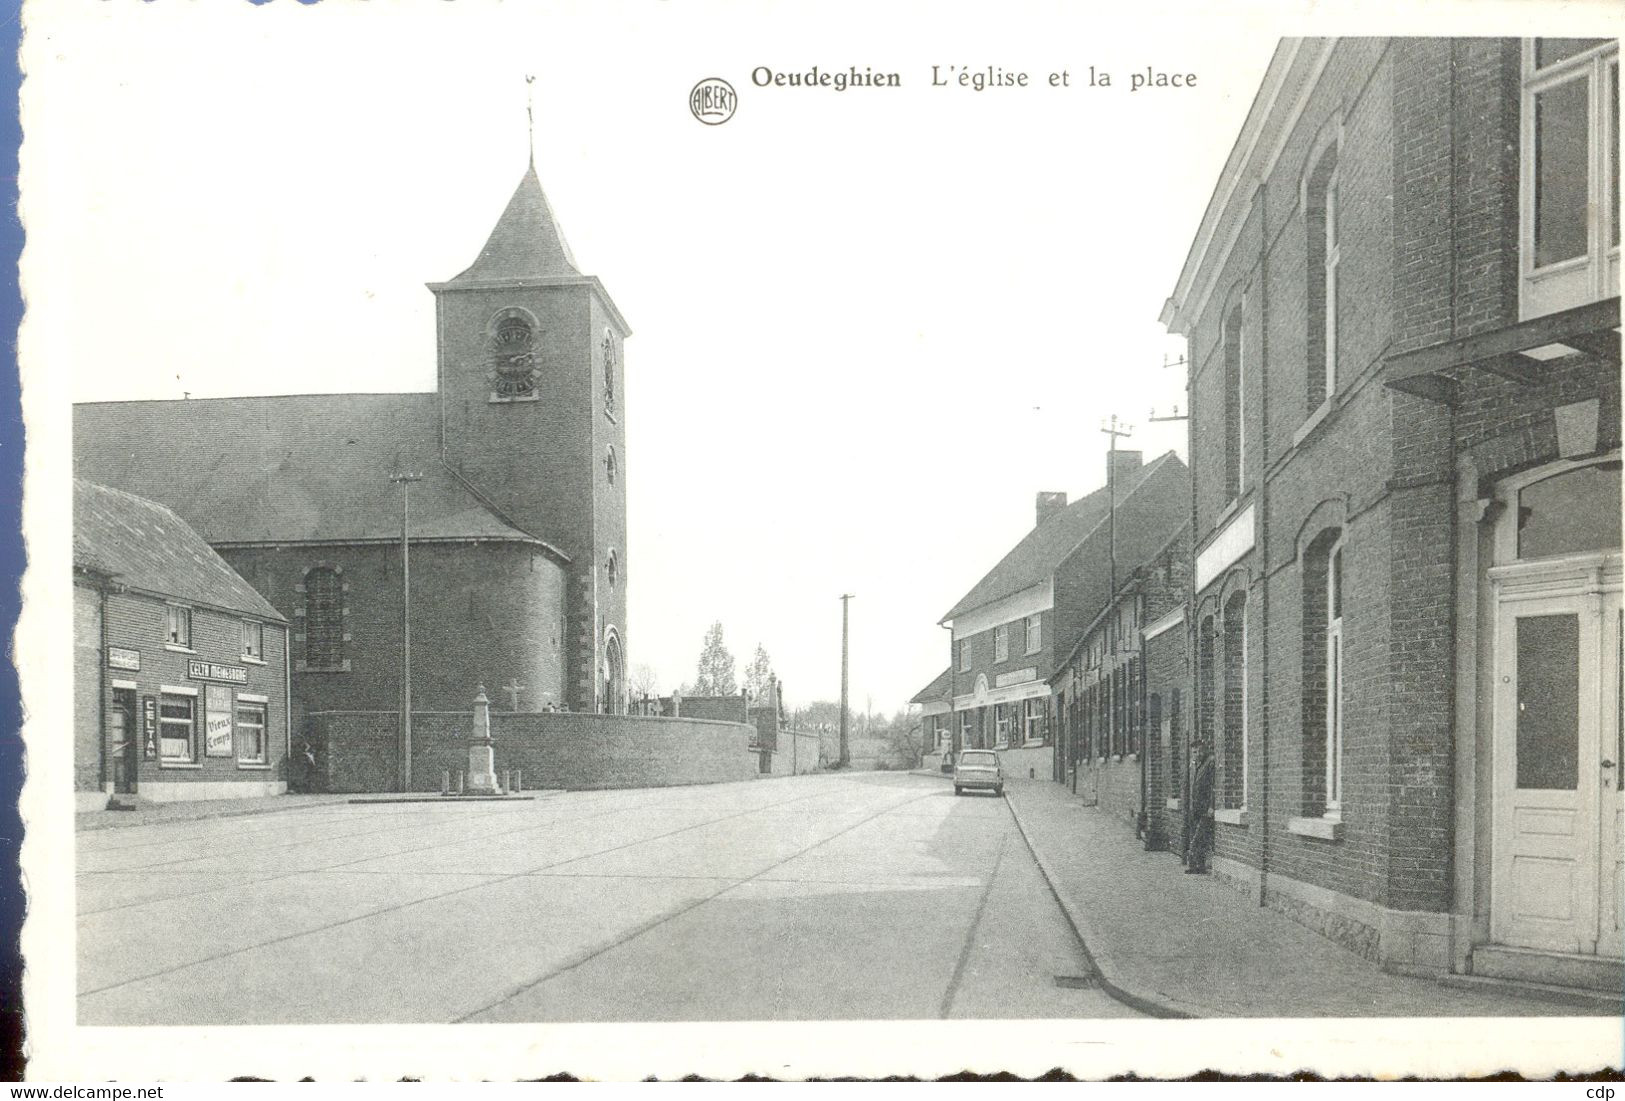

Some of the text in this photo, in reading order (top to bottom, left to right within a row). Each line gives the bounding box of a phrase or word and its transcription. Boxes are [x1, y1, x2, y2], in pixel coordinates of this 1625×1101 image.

[752, 66, 1197, 92] Oeudeghien L'église et la place
[691, 82, 737, 117] ALBERT
